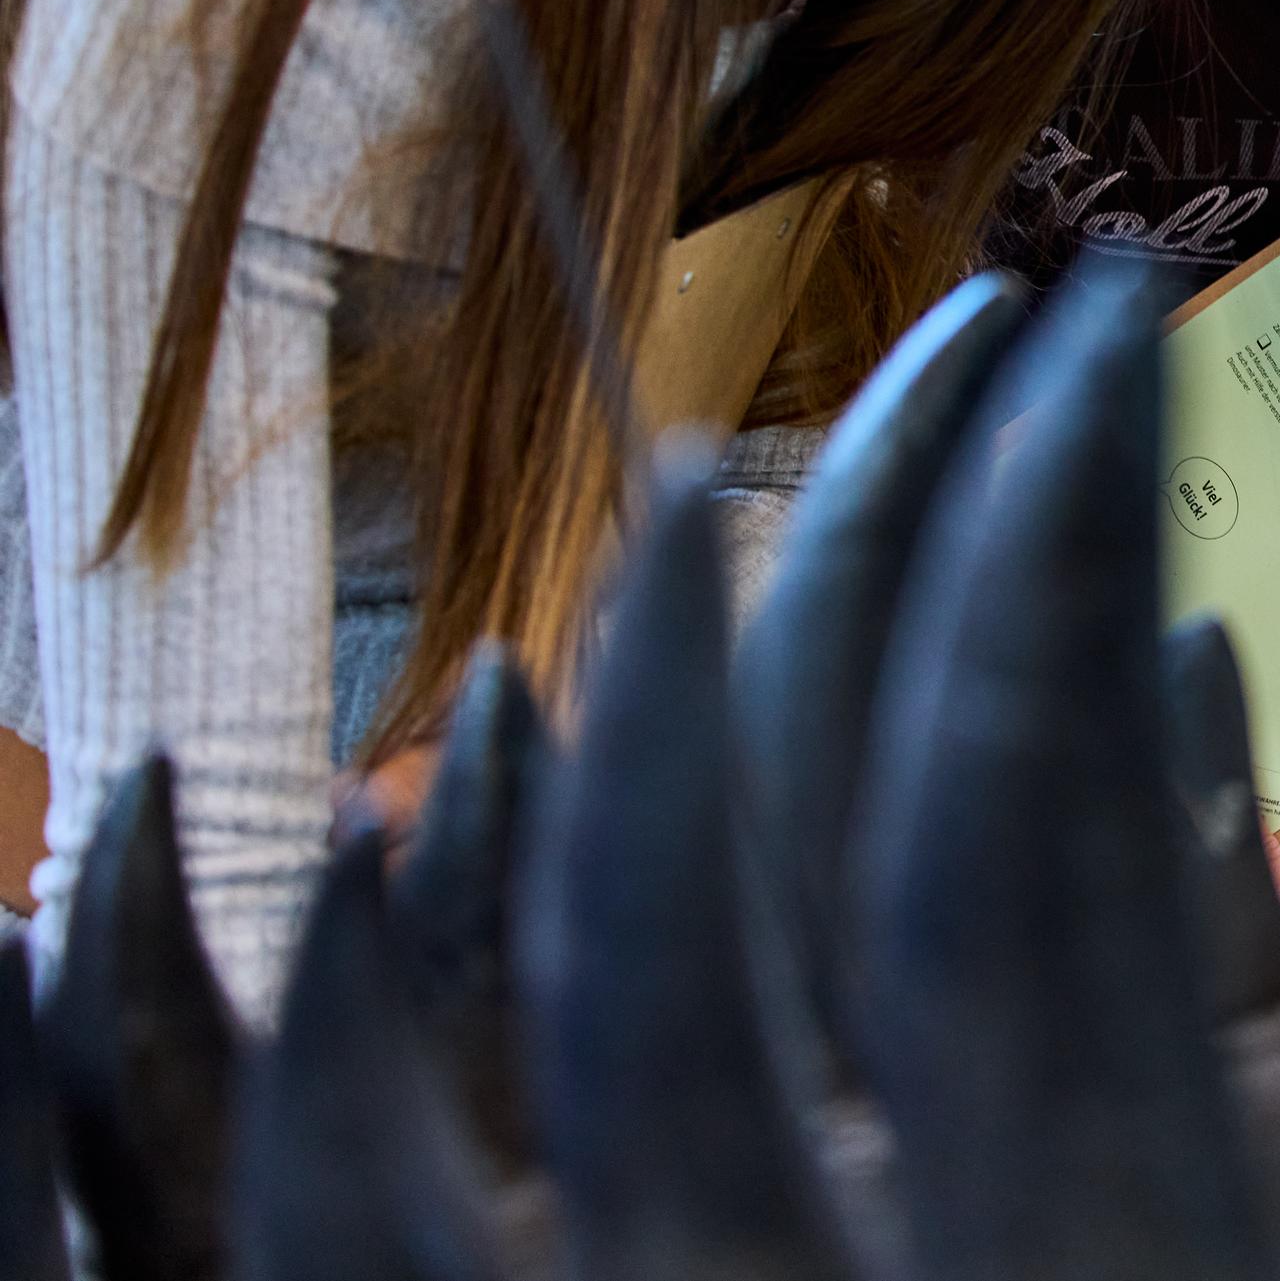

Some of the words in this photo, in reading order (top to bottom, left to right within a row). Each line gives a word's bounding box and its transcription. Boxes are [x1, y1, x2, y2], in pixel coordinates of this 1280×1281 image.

[1235, 350, 1248, 367] Auch
[1252, 377, 1265, 393] Hilfe
[1260, 391, 1272, 404] der
[1244, 344, 1255, 358] und
[1251, 356, 1269, 379] Muster
[1265, 378, 1278, 394] nach
[1176, 481, 1208, 521] Glück!
[1199, 479, 1222, 506] Viel
